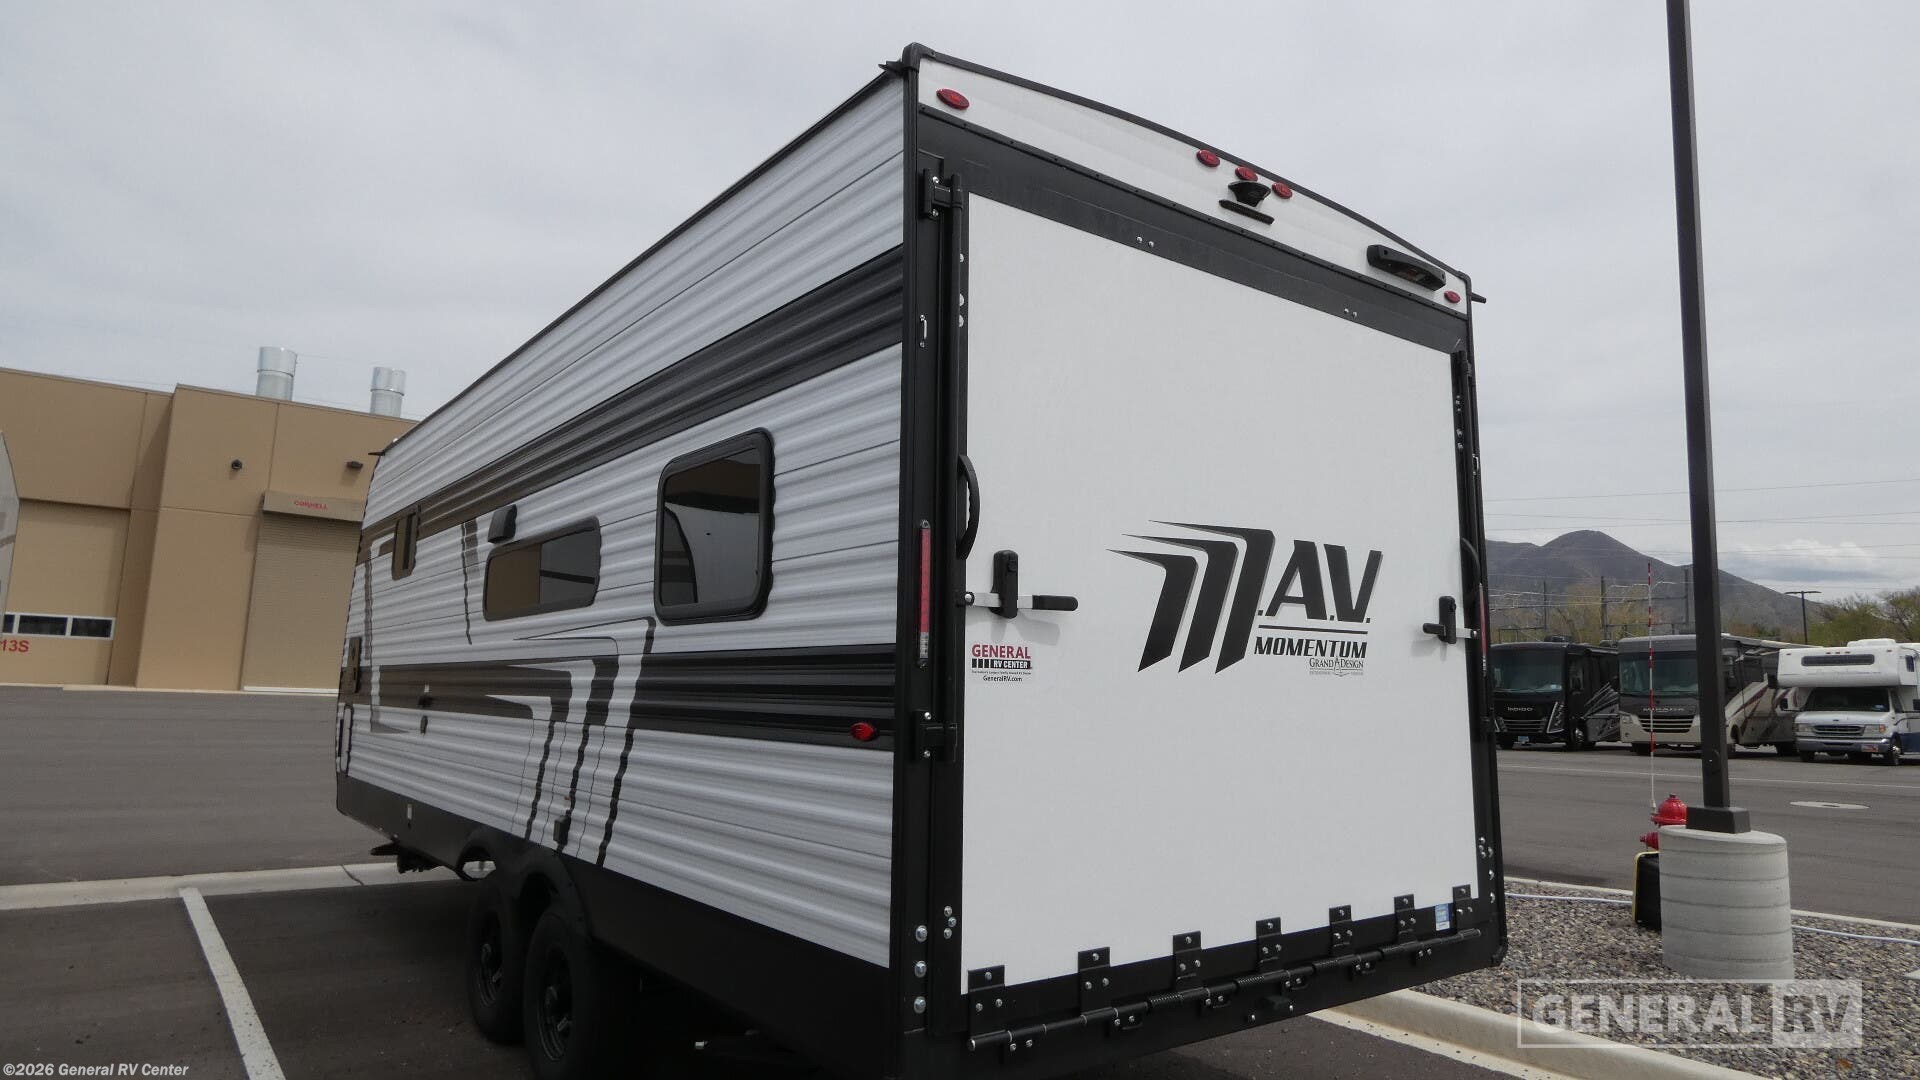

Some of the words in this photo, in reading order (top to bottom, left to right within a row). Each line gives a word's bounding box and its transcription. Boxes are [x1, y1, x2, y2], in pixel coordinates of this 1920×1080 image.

[971, 644, 1031, 659] GENERAL
[1254, 636, 1368, 659] MOMENTUM
[1003, 661, 1028, 669] CENTER
[1309, 657, 1335, 668] GRAND
[1340, 658, 1364, 669] DESIGN
